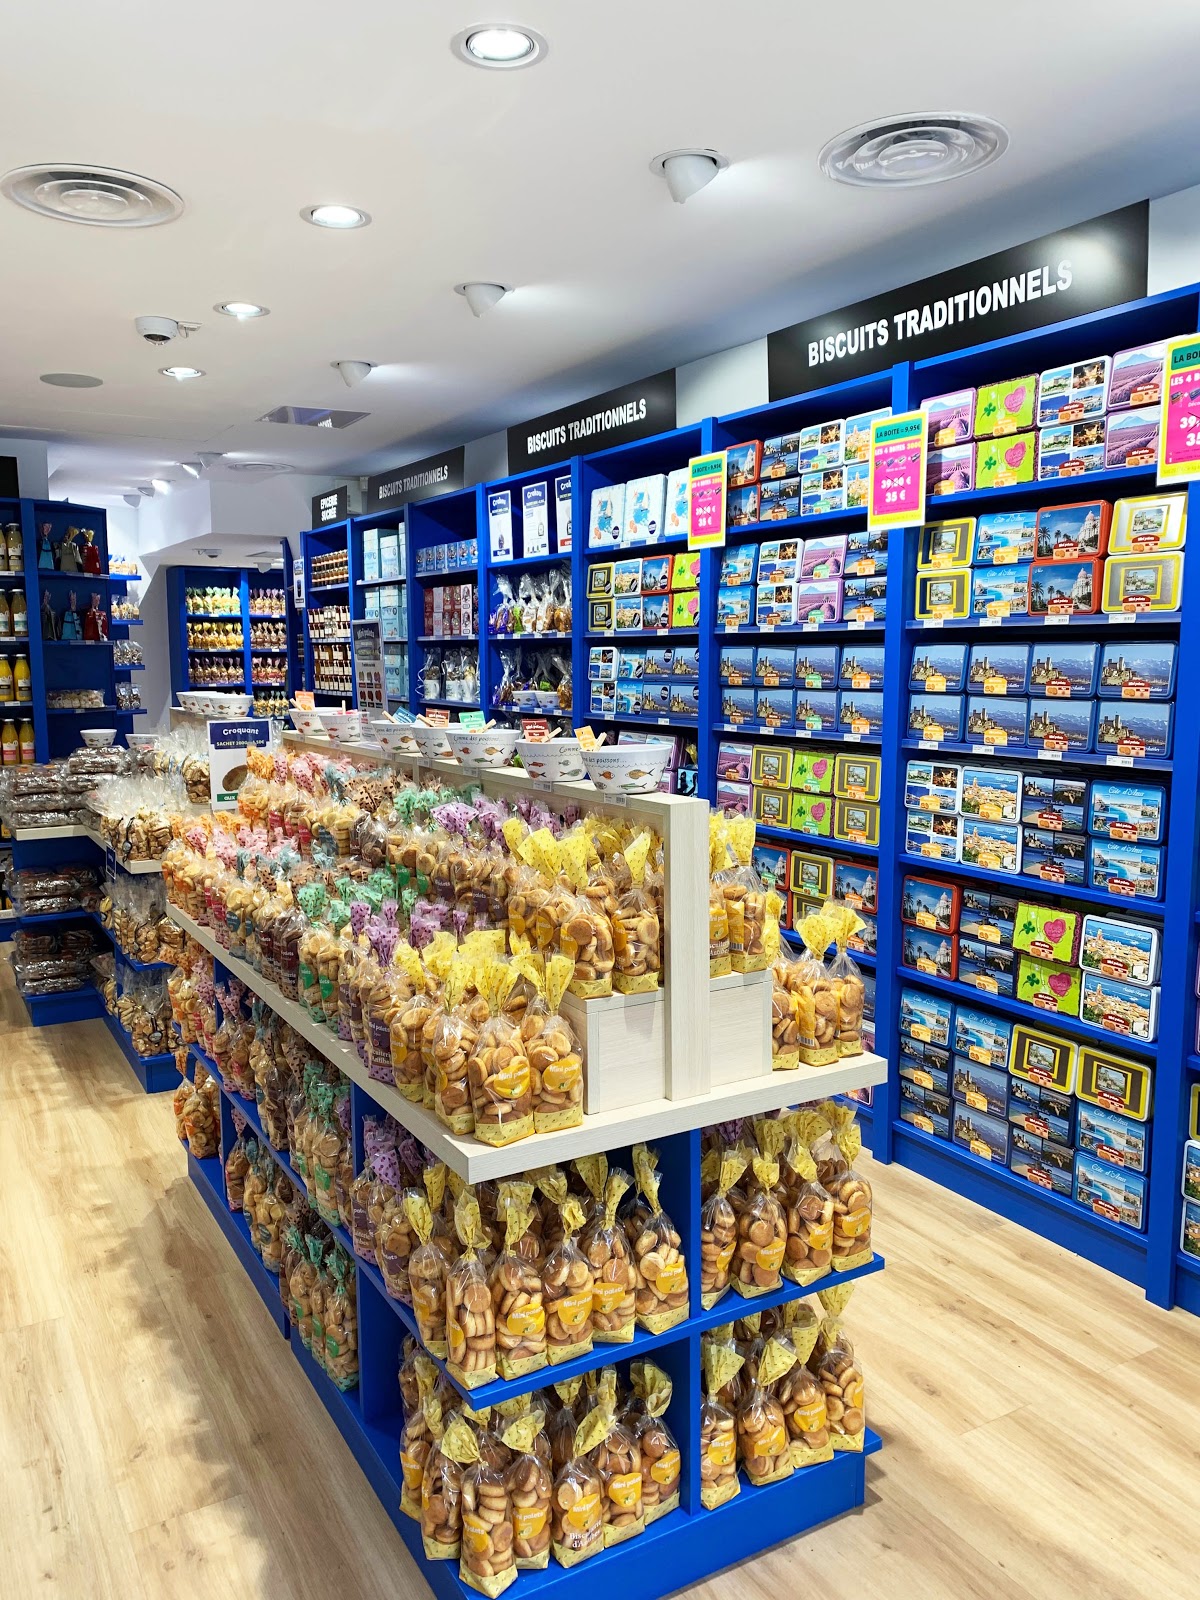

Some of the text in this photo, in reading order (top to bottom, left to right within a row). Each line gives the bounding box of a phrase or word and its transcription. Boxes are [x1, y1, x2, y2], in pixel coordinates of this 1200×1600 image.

[808, 259, 1073, 367] BISCUITS TRADITIONNELS
[1174, 354, 1184, 363] LA
[1171, 376, 1184, 386] LES
[1186, 374, 1192, 383] 4
[527, 399, 647, 454] BISCUITS TRADITIONNELS
[876, 424, 920, 439] LA BOITE 9,95€
[874, 447, 883, 455] LES
[884, 446, 888, 454] 4
[889, 443, 905, 453] BOITES
[379, 465, 448, 499] BISCUITS TRADITIONNELS
[906, 476, 911, 485] €
[885, 490, 905, 503] 35 €
[708, 516, 712, 525] €
[223, 728, 259, 736] Croquant
[1109, 786, 1145, 797] Côte d'Azur
[1107, 842, 1143, 854] Côte d'Azur
[499, 1071, 513, 1080] Mini
[1093, 1108, 1105, 1118] Côte
[1091, 1163, 1103, 1173] Côte
[563, 1300, 577, 1308] Mini
[512, 1311, 525, 1319] Mini
[613, 1481, 626, 1489] Mini
[573, 1504, 585, 1512] Mini
[523, 1510, 544, 1520] palets
